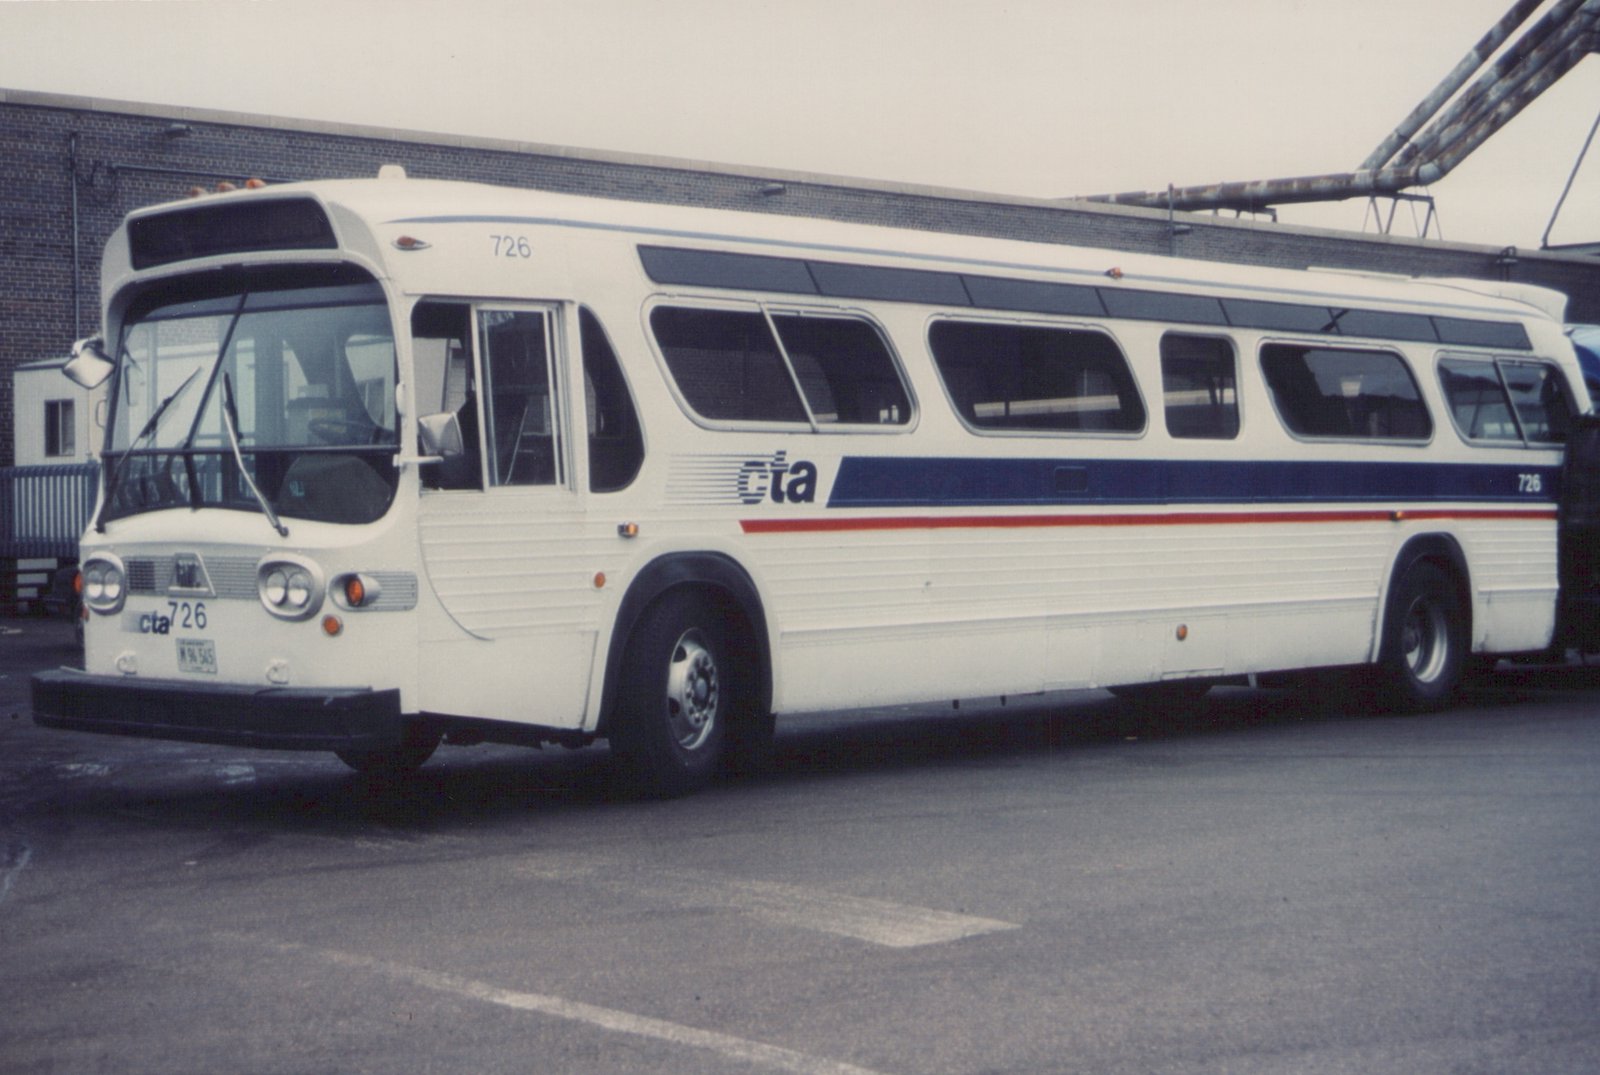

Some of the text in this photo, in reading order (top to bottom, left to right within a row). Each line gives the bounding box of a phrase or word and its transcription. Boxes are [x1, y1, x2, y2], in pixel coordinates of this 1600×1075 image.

[490, 235, 531, 258] 726
[738, 450, 817, 504] cta
[1518, 474, 1541, 492] 726
[140, 610, 170, 634] cta
[168, 601, 207, 629] 726
